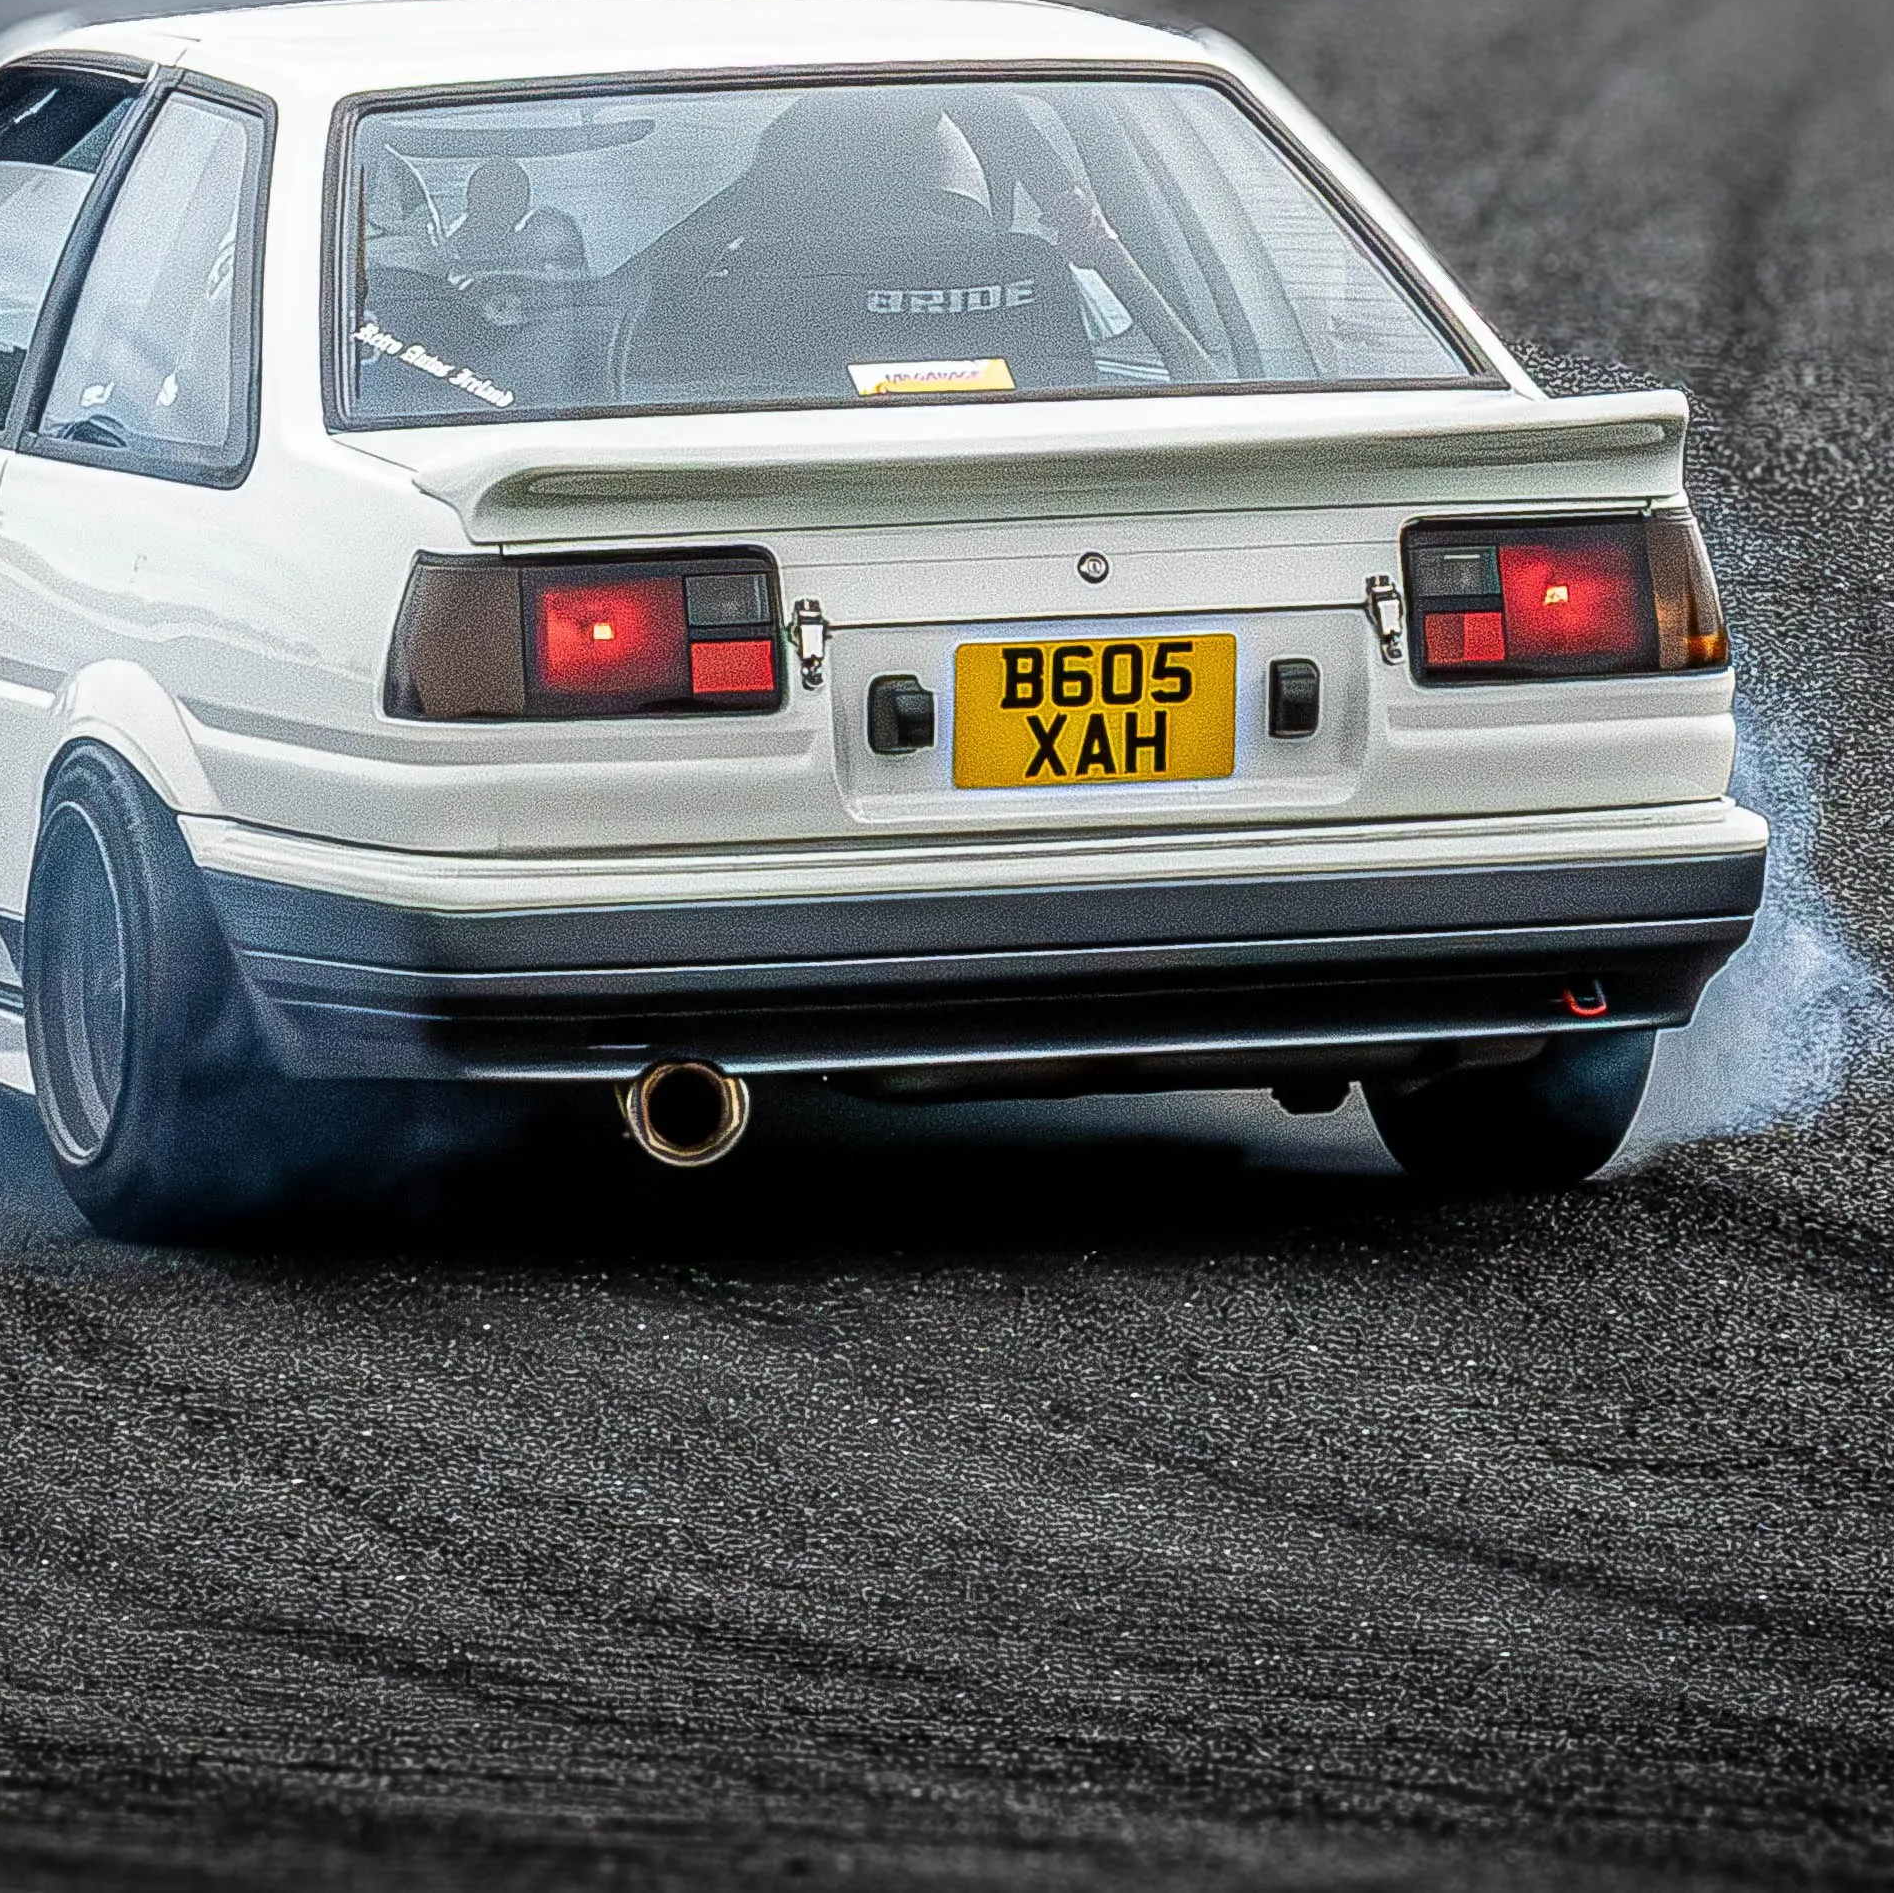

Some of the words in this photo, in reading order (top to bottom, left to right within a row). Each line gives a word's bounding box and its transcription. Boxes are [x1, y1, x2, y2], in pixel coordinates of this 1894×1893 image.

[866, 279, 1035, 313] BRIDE
[1000, 641, 1194, 710] B605
[1025, 710, 1168, 779] XAH
